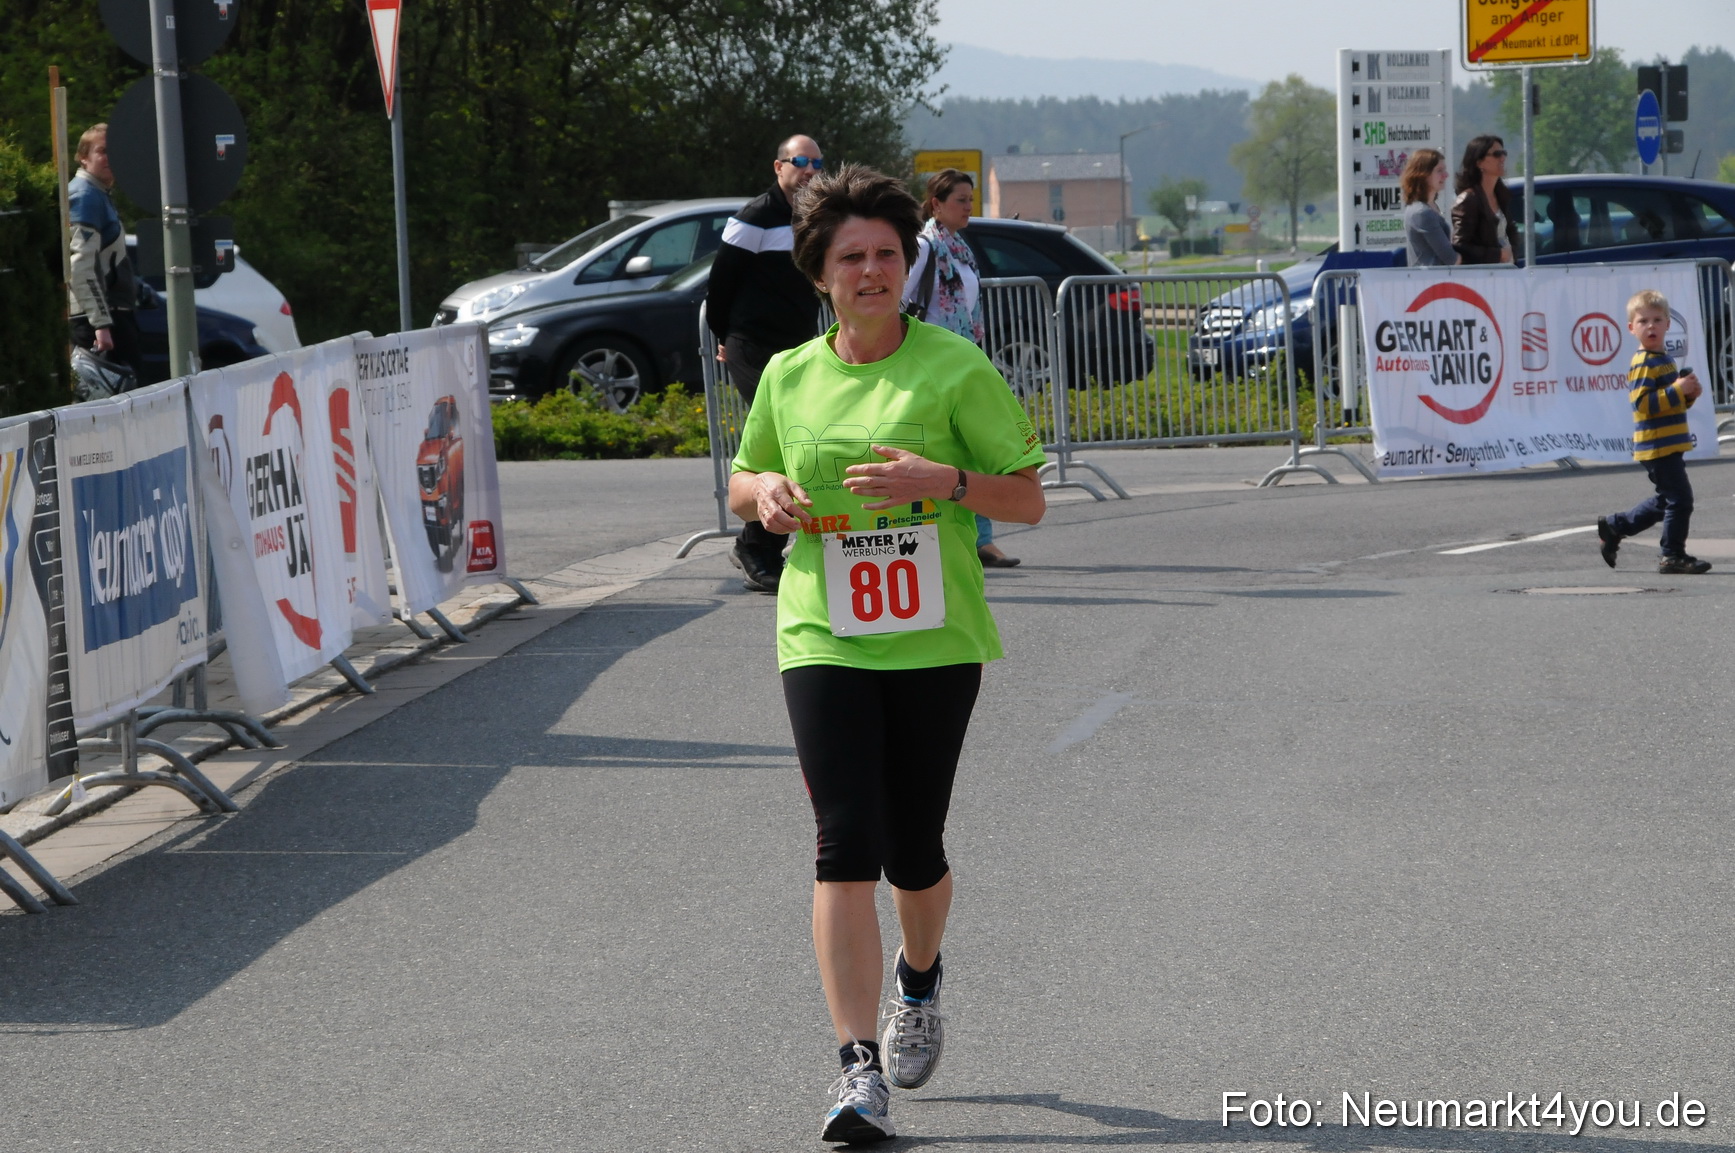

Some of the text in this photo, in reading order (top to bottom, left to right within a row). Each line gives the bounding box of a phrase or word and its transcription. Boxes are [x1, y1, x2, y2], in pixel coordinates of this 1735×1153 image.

[1491, 11, 1564, 26] am Anger
[1502, 37, 1545, 49] Neumarkt
[1387, 53, 1430, 67] HOLZAMMER
[1387, 86, 1431, 100] HOLZAMMER
[1364, 121, 1387, 146] SHB
[1375, 319, 1488, 353] GERHART &
[1580, 325, 1613, 353] KIA
[1375, 352, 1493, 386] Autohaus JÄNIG
[1513, 380, 1558, 396] SEAT
[1566, 377, 1585, 392] KIA
[1383, 444, 1434, 467] eumarkt
[841, 534, 894, 549] MEYER
[842, 546, 896, 558] WERBUNG
[850, 558, 920, 622] 80
